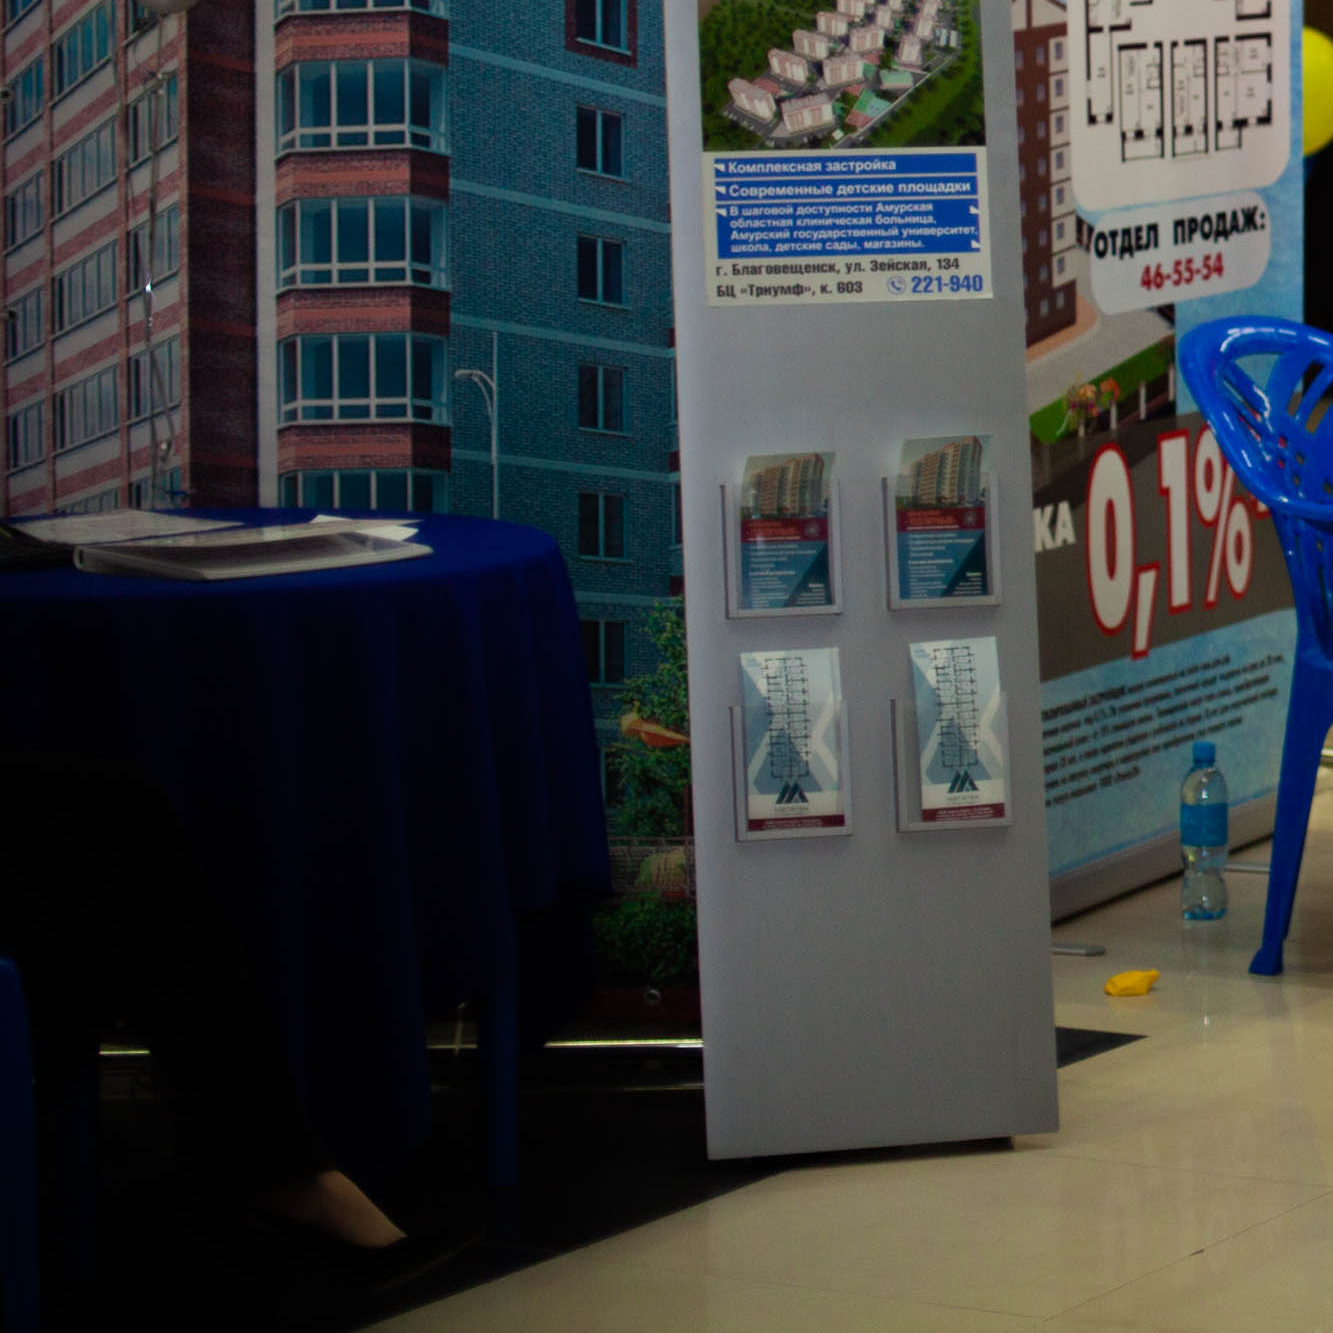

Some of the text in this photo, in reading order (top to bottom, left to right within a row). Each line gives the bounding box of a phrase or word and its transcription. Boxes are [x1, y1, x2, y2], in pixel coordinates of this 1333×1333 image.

[728, 159, 896, 174] Комплексная застройка
[729, 181, 971, 198] Современные детские площадки
[730, 202, 934, 217] В шаговой доступности Амурская
[730, 216, 793, 229] областная
[796, 216, 873, 227] клиническая
[730, 224, 978, 242] Амурский государственный университет,
[1094, 206, 1266, 259] ОТДЕЛ ПРОДАЖ:
[775, 241, 822, 252] детские
[863, 238, 926, 249] магазины.
[715, 258, 960, 277] г. Благовещенск, ул. Зейская, 134
[1141, 252, 1224, 290] 46-55-54
[716, 284, 736, 298] БЦ
[819, 284, 832, 295] к.
[837, 281, 863, 294] 603
[911, 274, 983, 294] 221-940
[1086, 422, 1254, 660] 0,1%
